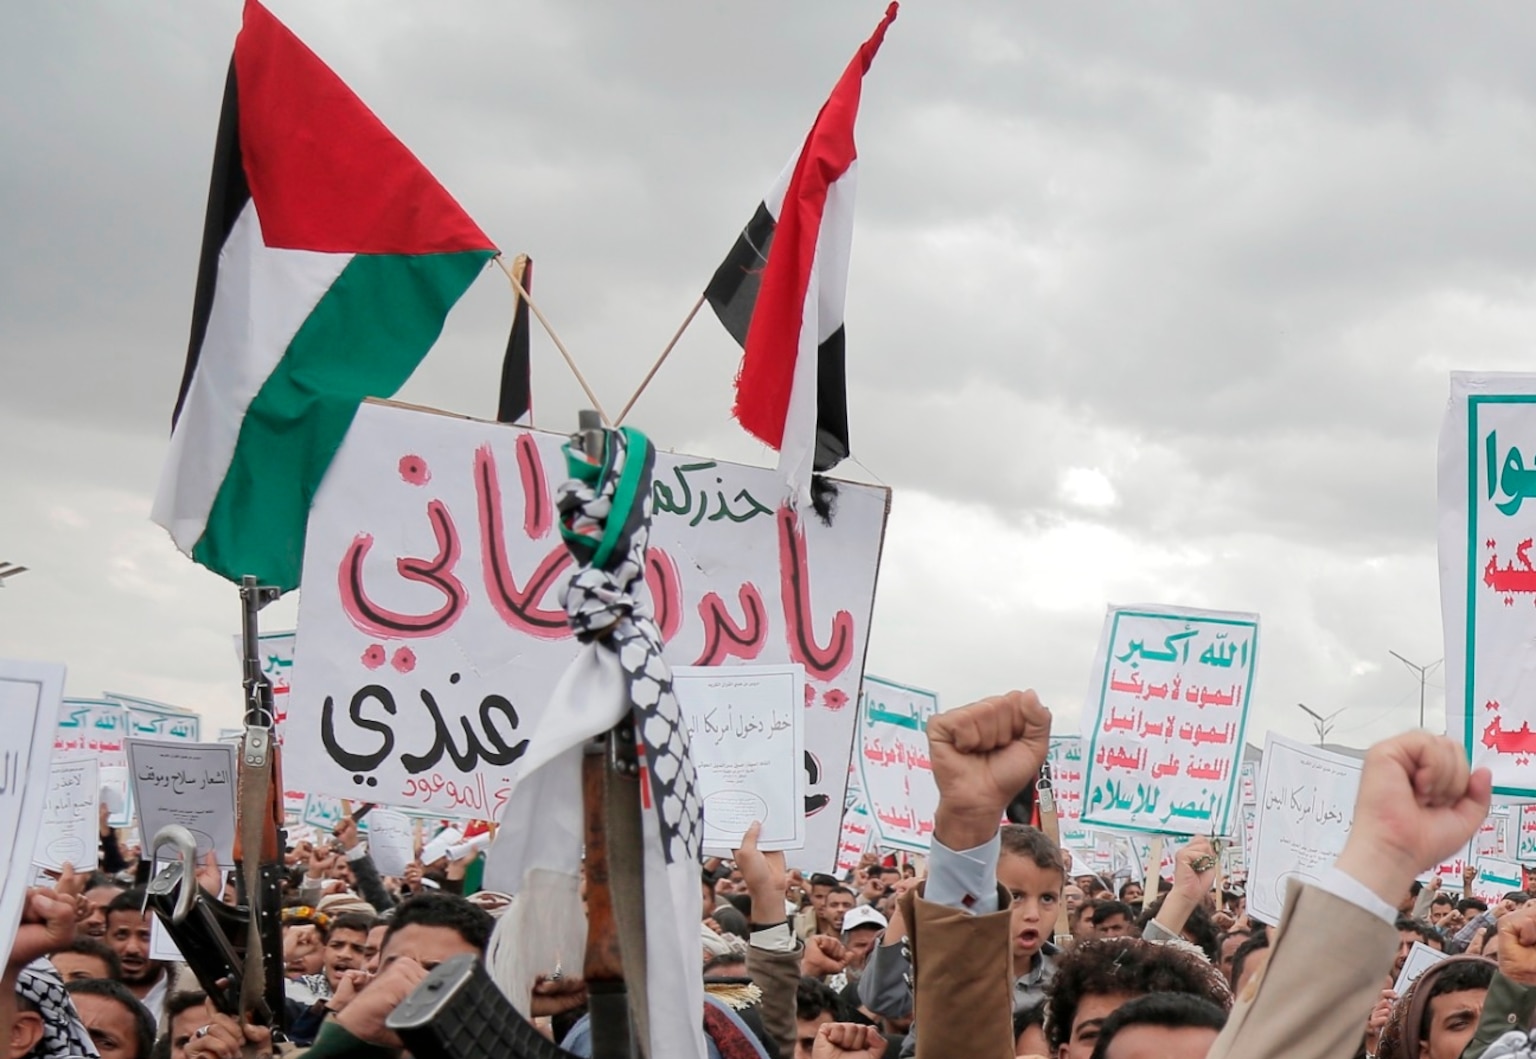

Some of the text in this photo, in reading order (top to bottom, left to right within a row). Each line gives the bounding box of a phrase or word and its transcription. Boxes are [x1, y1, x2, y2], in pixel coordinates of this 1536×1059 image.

[1113, 623, 1247, 669] الله أكبر
[1109, 669, 1242, 709] الموت لأمريكا
[94, 710, 124, 730] الله
[169, 719, 195, 738] الله
[320, 672, 530, 787] عندي
[704, 704, 792, 745] خطر دخول أمريكا
[1103, 706, 1235, 745] الموت لإسرائيل
[138, 764, 230, 795] الشعار سلاح وموقف
[1096, 743, 1229, 781] اللعنة على اليهود
[402, 773, 490, 818] الموعود
[1089, 775, 1223, 824] النصر للإسلام
[1266, 786, 1288, 810] اليمن
[1290, 786, 1318, 824] أمريكا
[1315, 799, 1343, 826] دخول
[874, 802, 934, 836] سرائيلية
[1478, 865, 1522, 888] طعوا
